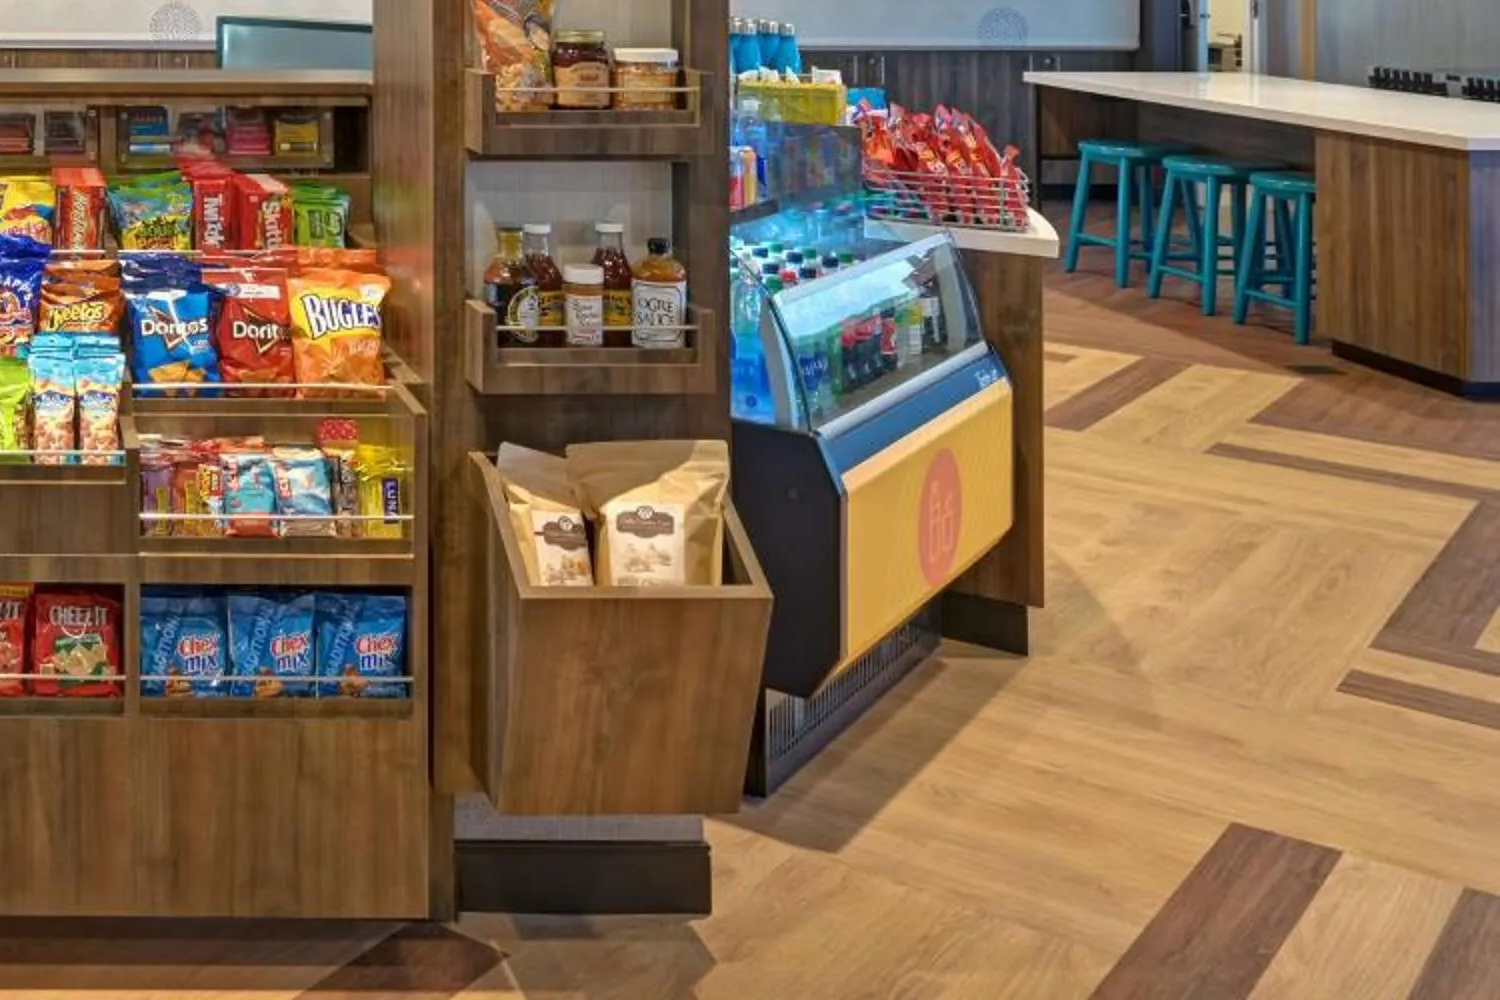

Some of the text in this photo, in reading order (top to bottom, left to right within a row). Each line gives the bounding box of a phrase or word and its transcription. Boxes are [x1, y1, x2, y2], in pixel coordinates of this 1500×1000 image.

[178, 632, 221, 656] Chex
[271, 632, 310, 656] Chex
[355, 633, 399, 656] Chex
[183, 655, 219, 676] mix
[276, 655, 309, 674] mix
